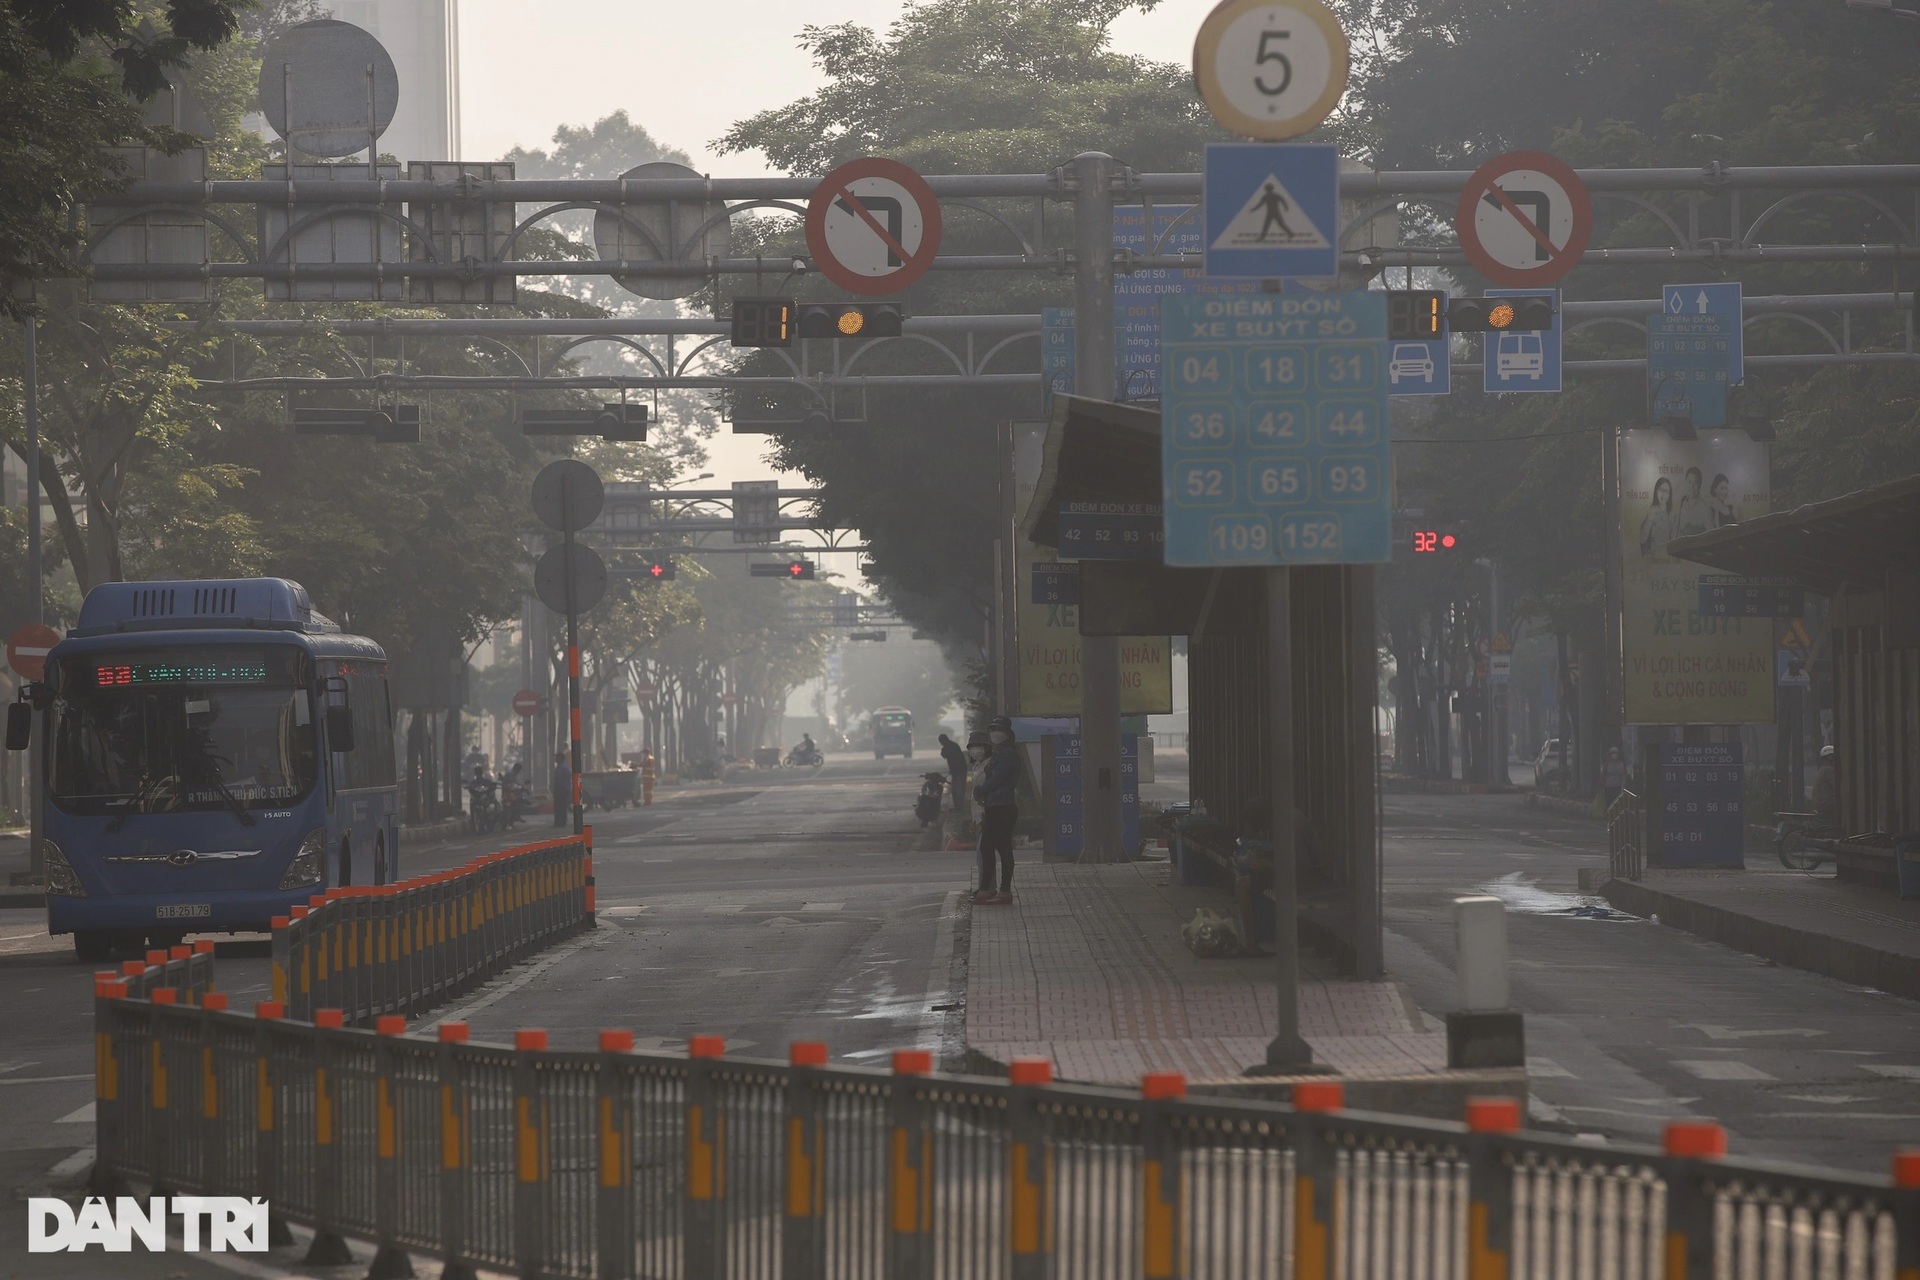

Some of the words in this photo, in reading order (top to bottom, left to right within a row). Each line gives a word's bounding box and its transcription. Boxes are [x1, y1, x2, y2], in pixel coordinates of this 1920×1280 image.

[1254, 30, 1292, 96] 5
[1282, 296, 1342, 315] ĐÓN
[780, 306, 788, 340] 1
[1432, 298, 1438, 332] 1
[1192, 321, 1227, 338] XE
[1236, 317, 1308, 337] BUÝT
[1318, 316, 1357, 336] SỐ
[1051, 334, 1065, 344] 04
[1654, 342, 1665, 350] 01
[1674, 341, 1686, 350] 02
[1694, 340, 1706, 350] 03
[1053, 356, 1066, 367] 36
[1184, 356, 1219, 384] 04
[1260, 356, 1295, 384] 18
[1328, 355, 1362, 382] 31
[1654, 370, 1666, 380] 45
[1695, 370, 1706, 380] 56
[1052, 380, 1066, 390] 52
[1188, 413, 1225, 439] 36
[1257, 412, 1294, 437] 42
[1329, 410, 1366, 436] 44
[1187, 470, 1223, 496] 52
[1262, 468, 1298, 494] 65
[1330, 466, 1367, 492] 93
[1128, 504, 1142, 512] XE
[1066, 529, 1080, 540] 42
[1096, 530, 1110, 541] 52
[1124, 530, 1139, 542] 93
[1215, 525, 1267, 550] 109
[1284, 522, 1338, 548] 152
[1415, 532, 1436, 552] 32
[1047, 604, 1075, 628] XE
[1652, 610, 1681, 635] XE
[1122, 644, 1160, 665] NHÂN
[1634, 654, 1646, 674] VÌ
[1046, 672, 1054, 688] &
[1652, 682, 1661, 698] &
[1060, 764, 1071, 774] 04
[1122, 763, 1132, 772] 36
[1666, 772, 1676, 781] 01
[1686, 772, 1696, 782] 02
[1706, 772, 1718, 781] 03
[1728, 772, 1738, 780] 19
[1060, 794, 1072, 804] 42
[1122, 794, 1134, 804] 65
[1666, 802, 1678, 812] 45
[1686, 802, 1697, 812] 53
[1706, 802, 1718, 812] 56
[1728, 802, 1738, 812] 88
[1062, 824, 1072, 834] 93
[1690, 832, 1702, 842] D1
